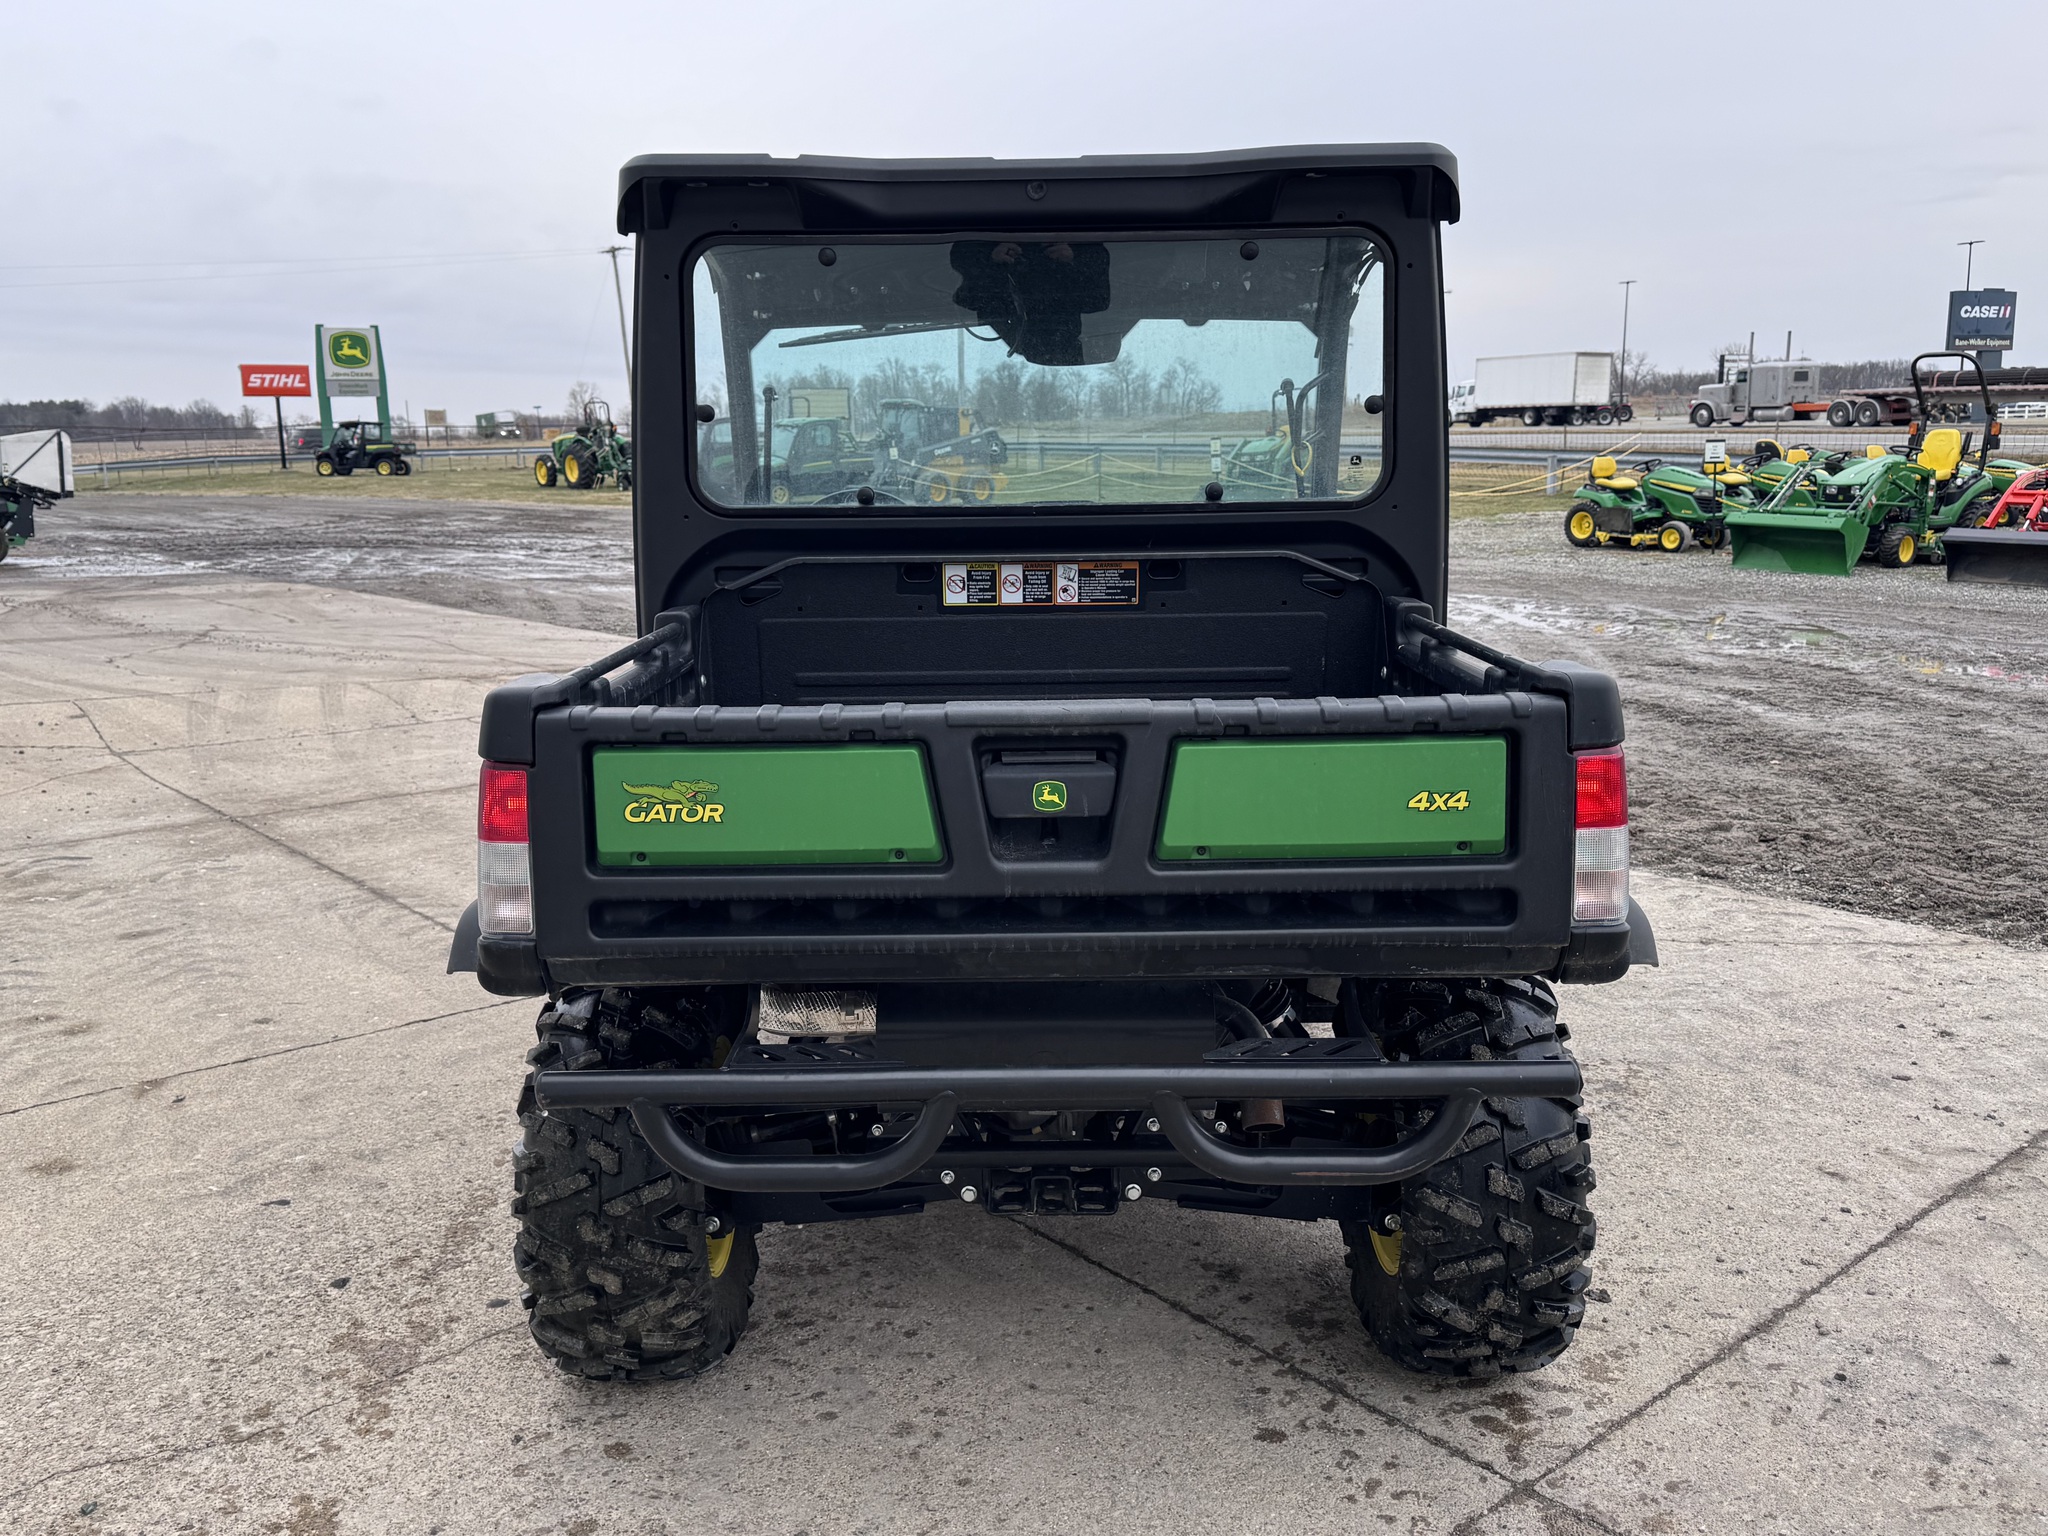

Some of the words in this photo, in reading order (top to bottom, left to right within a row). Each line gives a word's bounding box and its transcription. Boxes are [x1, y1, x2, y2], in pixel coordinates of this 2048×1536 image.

[1960, 305, 1999, 318] CASE
[1987, 338, 2010, 347] Equipment
[247, 373, 306, 388] STIHL
[624, 802, 725, 824] GATOR
